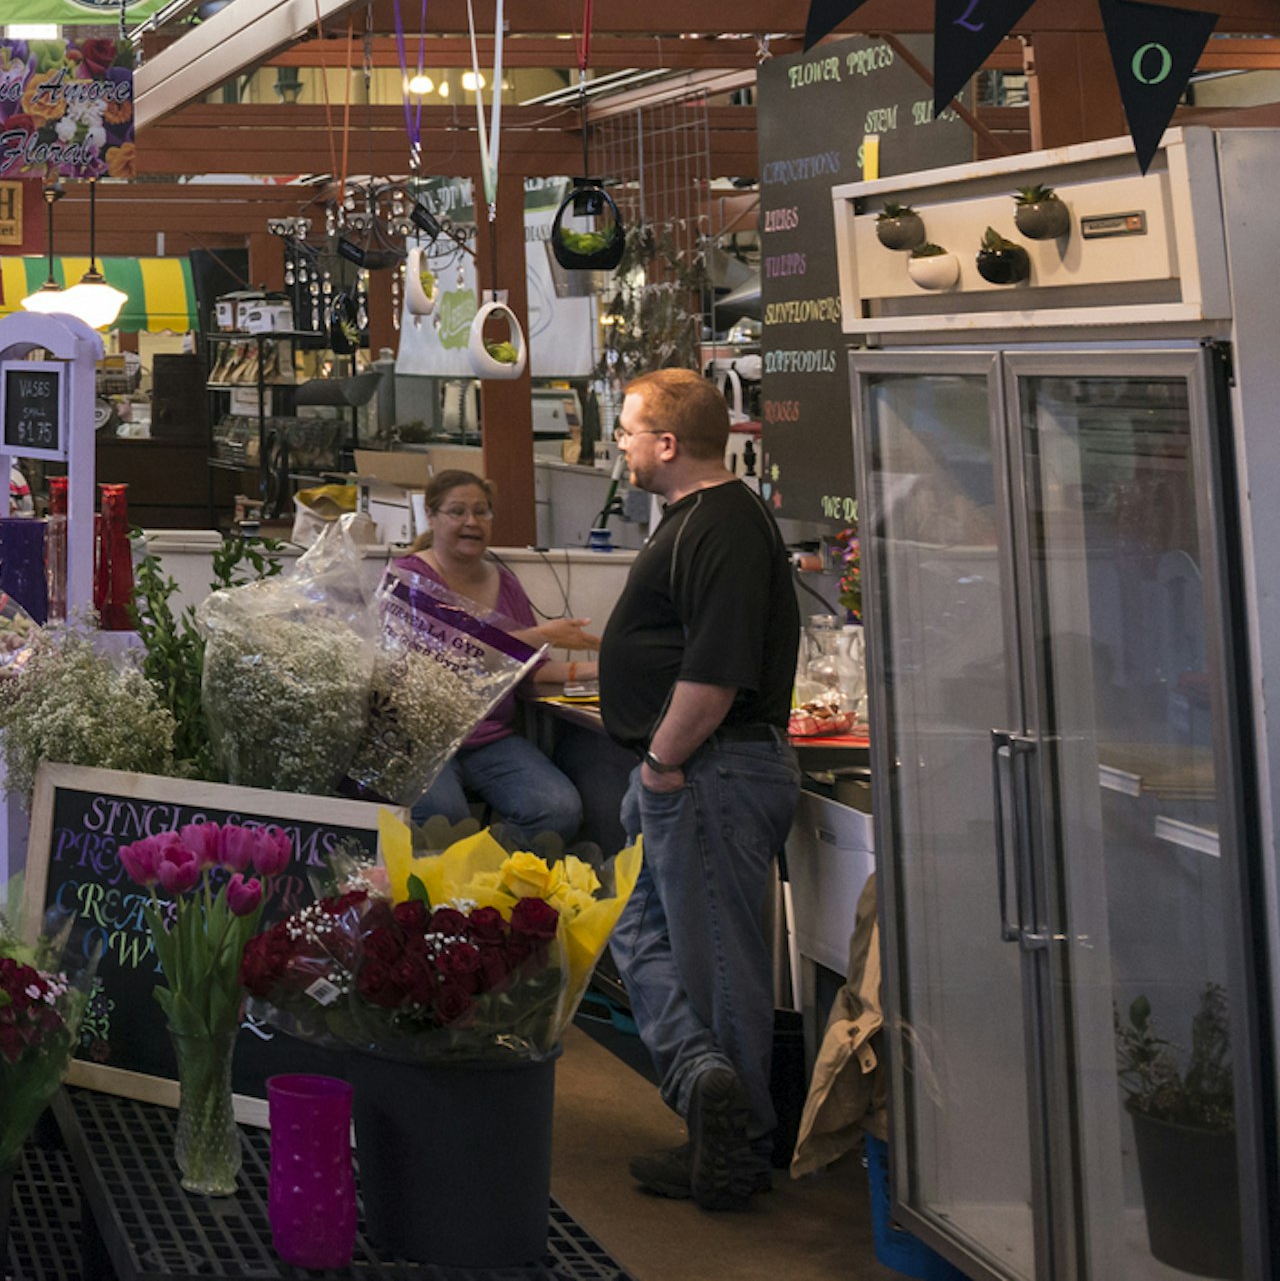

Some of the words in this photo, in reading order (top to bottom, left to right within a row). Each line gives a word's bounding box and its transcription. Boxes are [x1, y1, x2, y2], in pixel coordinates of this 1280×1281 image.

[788, 55, 842, 89] FLOWER
[846, 44, 894, 77] PRICES
[1131, 41, 1173, 86] O
[31, 66, 131, 105] Amore
[864, 103, 899, 134] STEM
[764, 296, 841, 326] SUNFLOWERS
[764, 348, 837, 373] DAFFODILS
[19, 379, 51, 398] VASES
[764, 399, 800, 424] ROSES
[83, 796, 207, 838] SINGL
